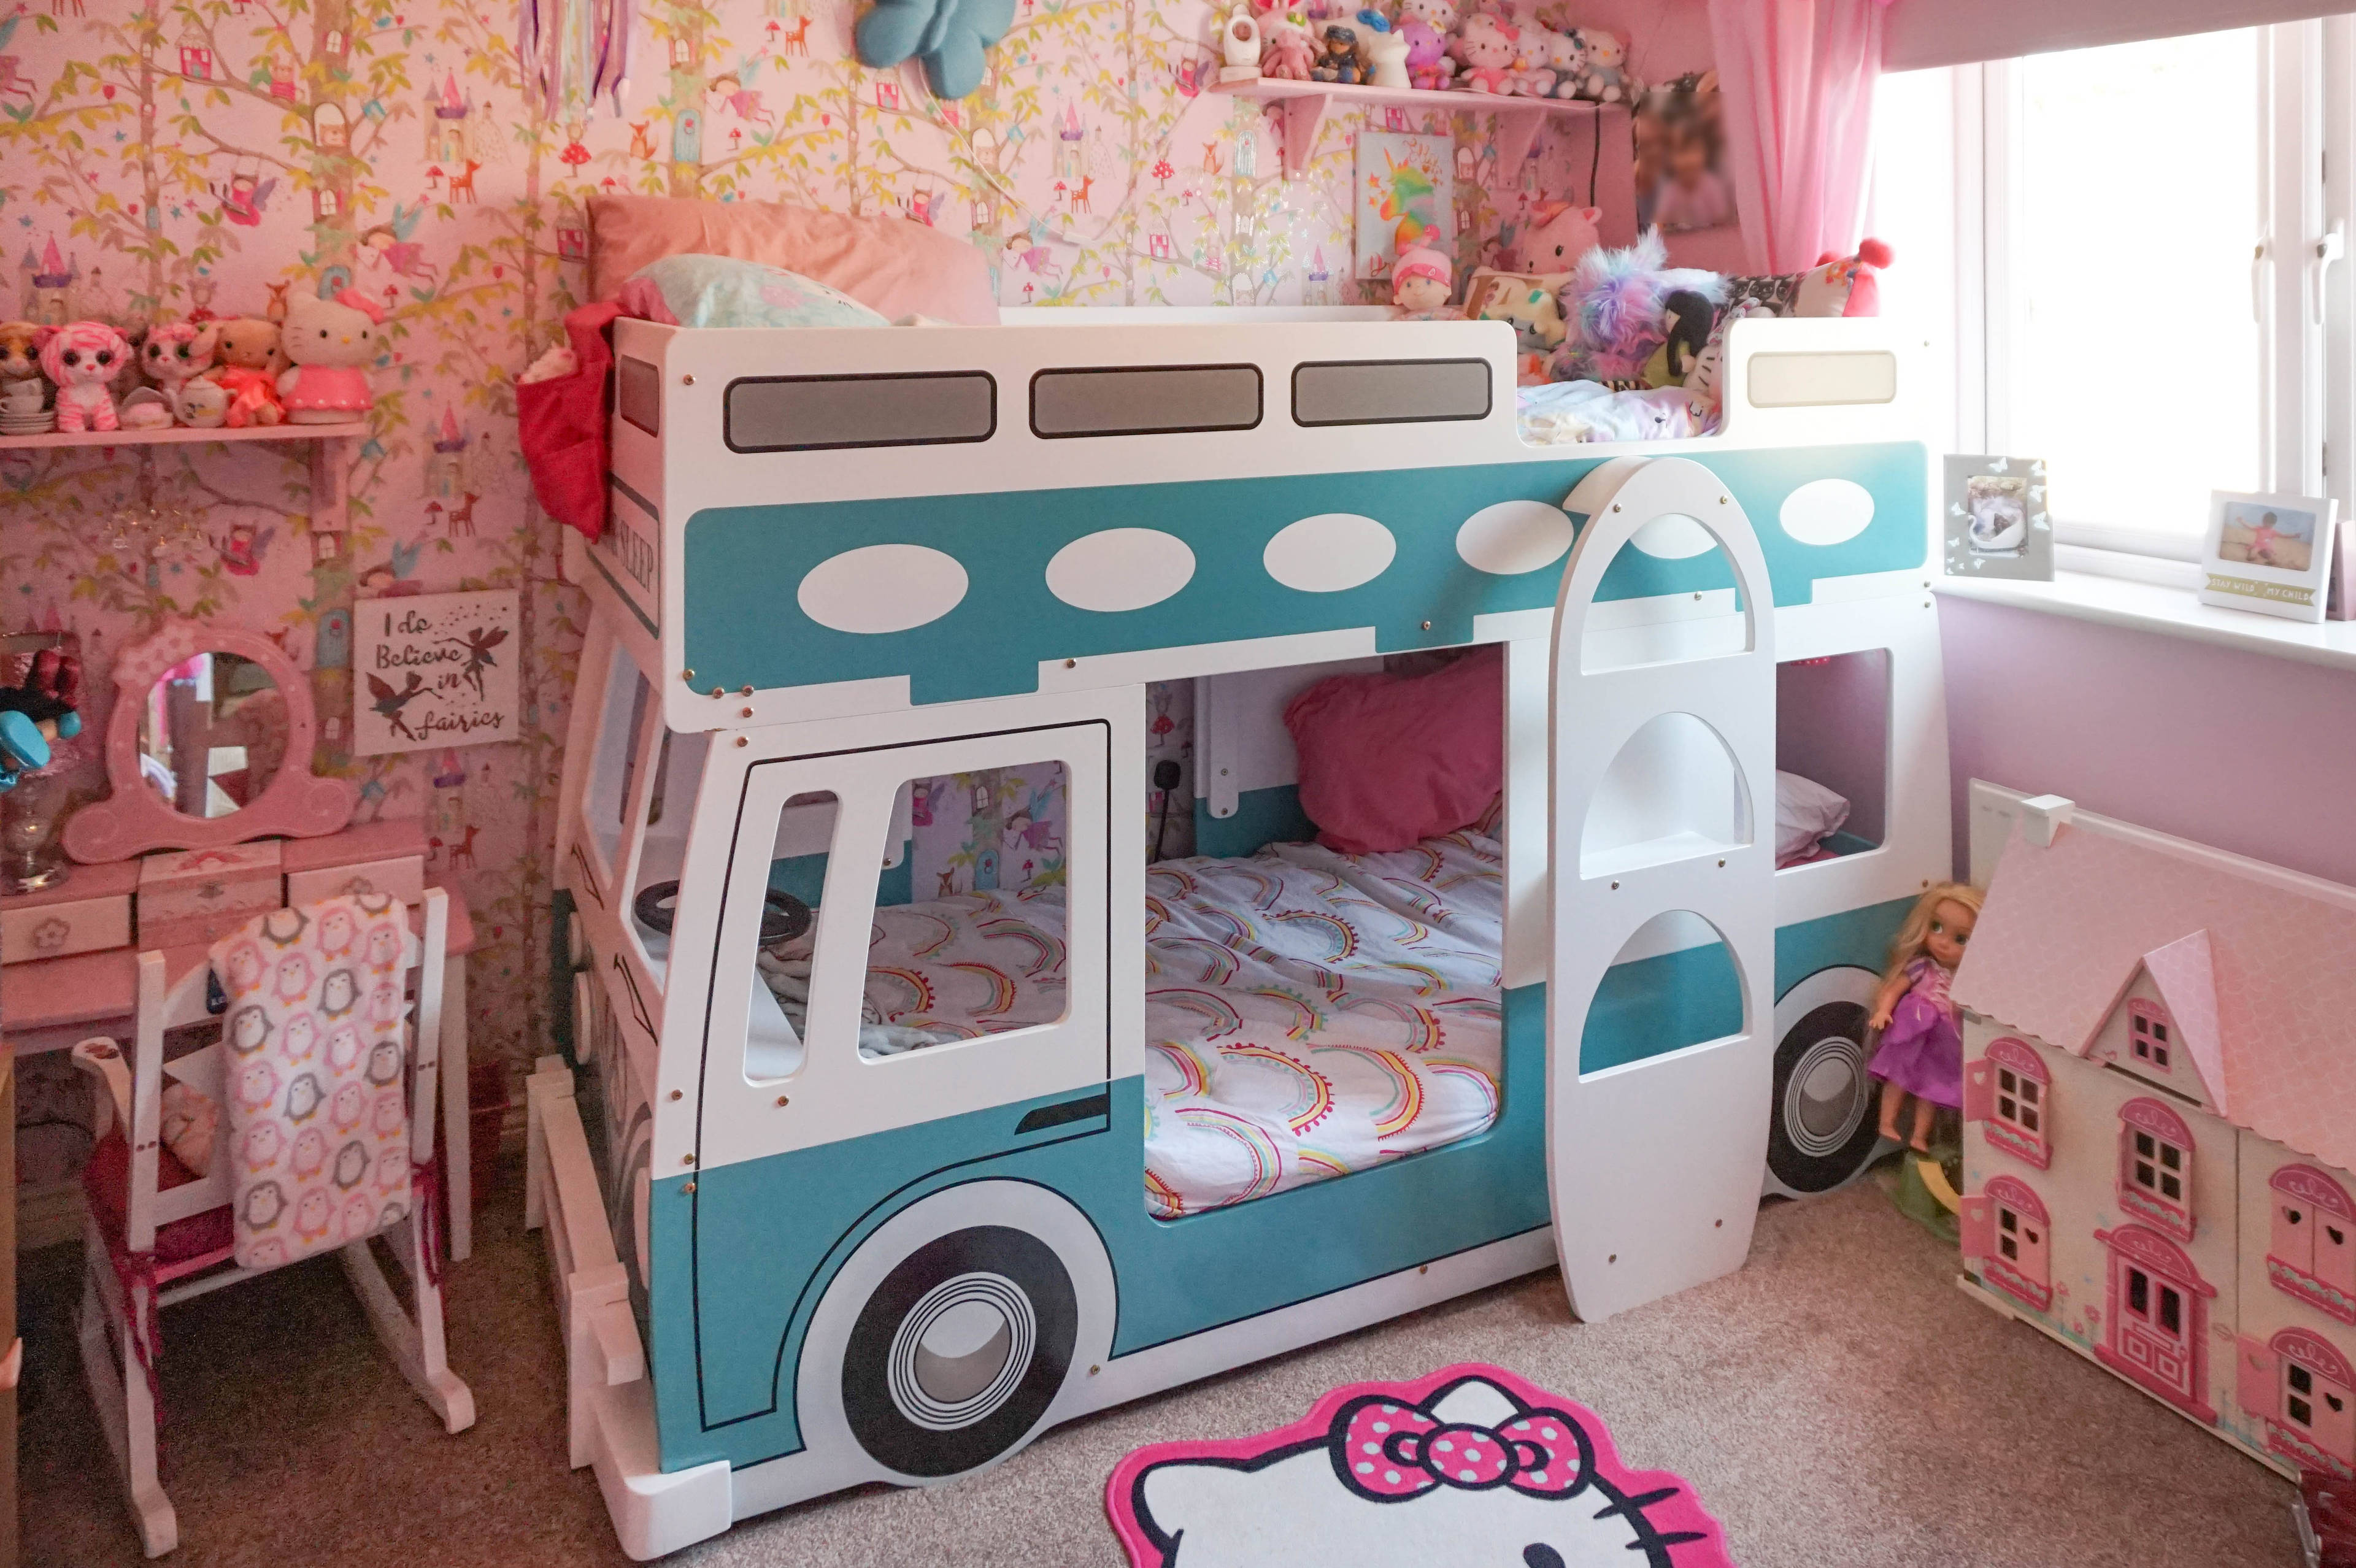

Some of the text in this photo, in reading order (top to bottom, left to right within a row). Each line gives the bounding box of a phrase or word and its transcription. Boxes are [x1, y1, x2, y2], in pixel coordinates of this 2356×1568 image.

[2212, 578, 2309, 601] STAY WILD MY CHILD
[384, 610, 433, 636] I do
[376, 645, 462, 669] Believe
[438, 673, 460, 690] in
[415, 710, 504, 740] fairies
